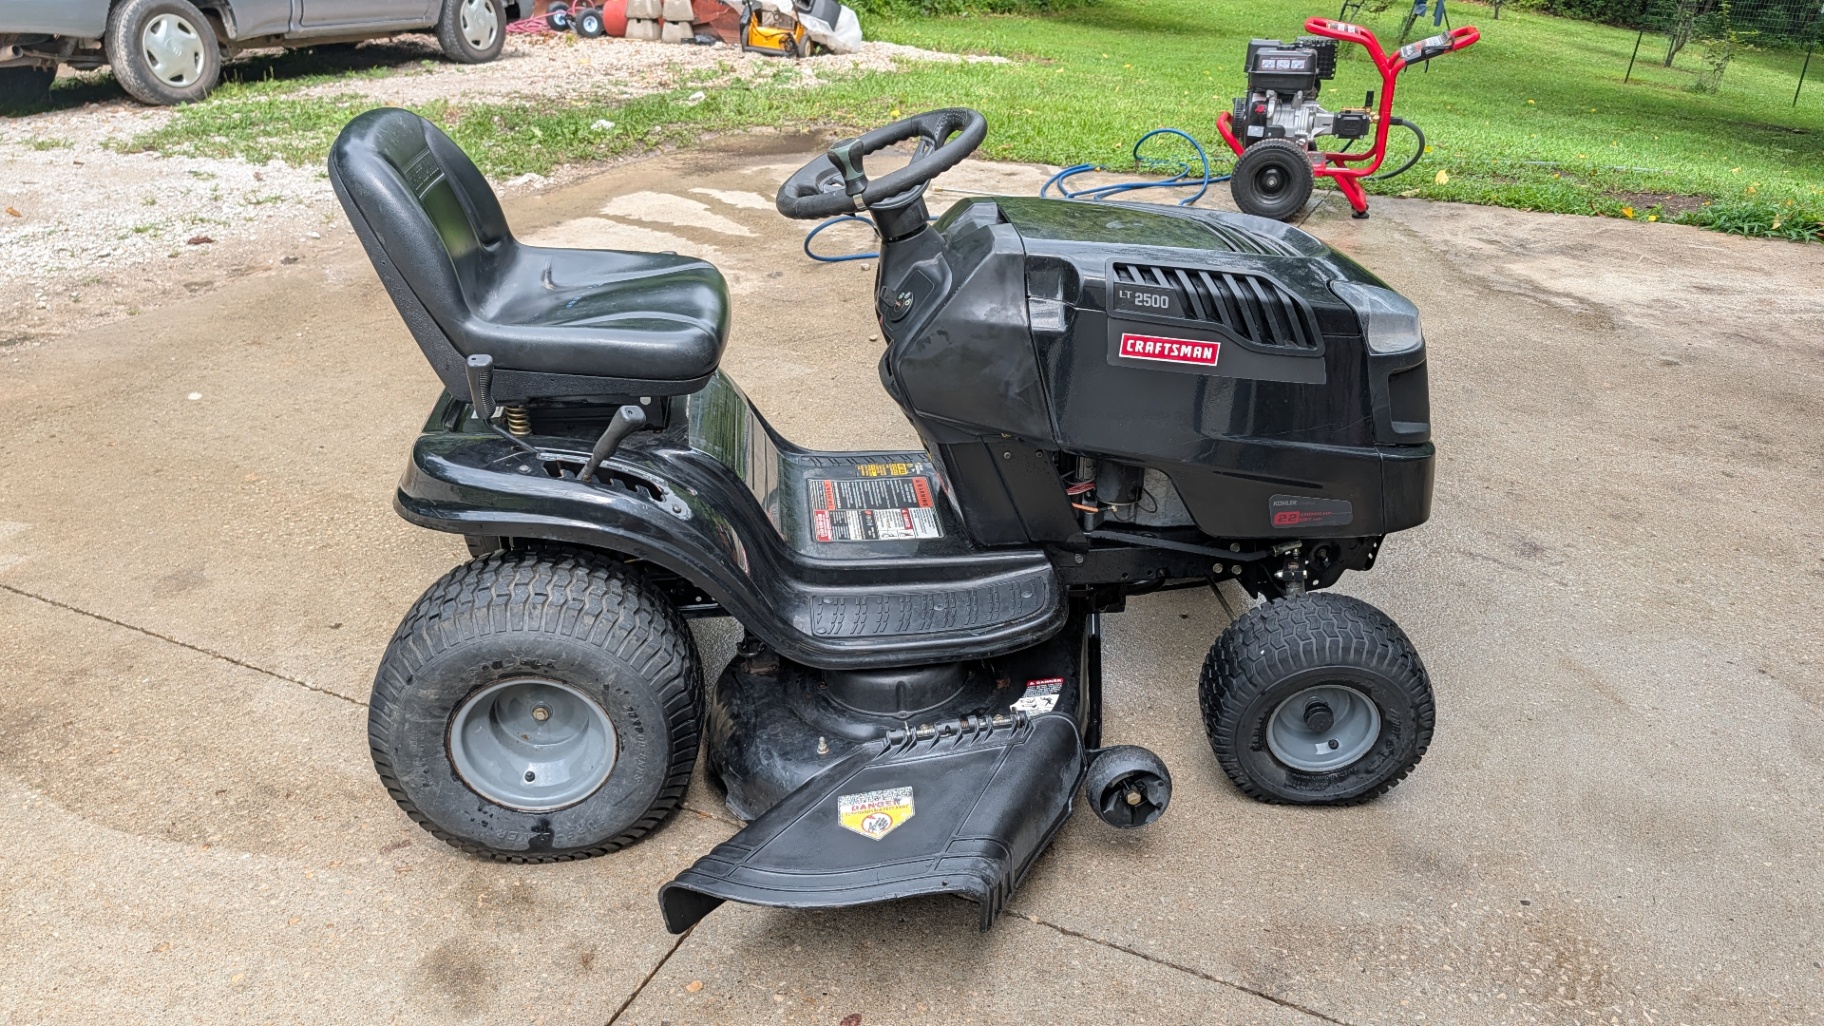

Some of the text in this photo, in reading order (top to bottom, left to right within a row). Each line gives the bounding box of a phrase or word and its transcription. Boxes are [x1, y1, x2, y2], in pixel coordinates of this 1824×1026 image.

[1119, 290, 1170, 309] LT 2500
[1126, 338, 1214, 360] CRAFTSMAN
[851, 798, 901, 811] DANGER
